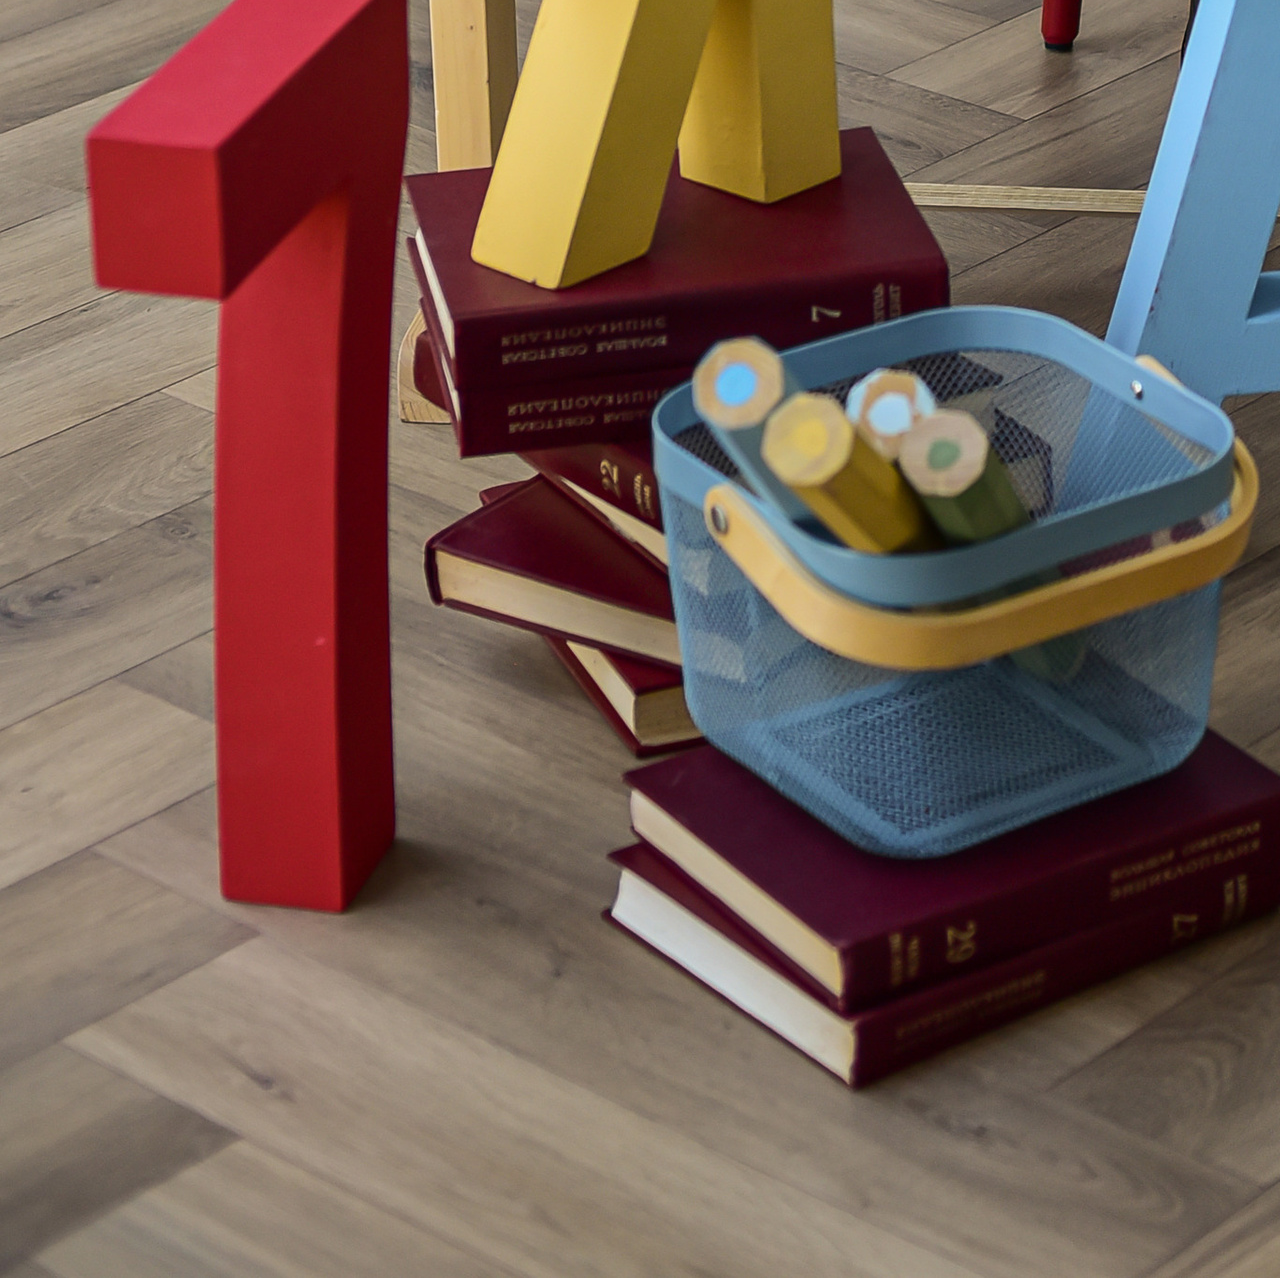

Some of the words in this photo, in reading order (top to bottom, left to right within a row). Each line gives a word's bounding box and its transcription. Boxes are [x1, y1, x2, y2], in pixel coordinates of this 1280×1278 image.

[810, 304, 842, 323] 7
[501, 315, 667, 347] ЭНЦИКЛОПЕДИЯ
[502, 343, 588, 365] СОВЕТСКАЯ
[596, 334, 668, 353] БОЛЬШАЯ
[508, 414, 596, 434] СОВЕТСКАЯ
[945, 919, 978, 964] 29
